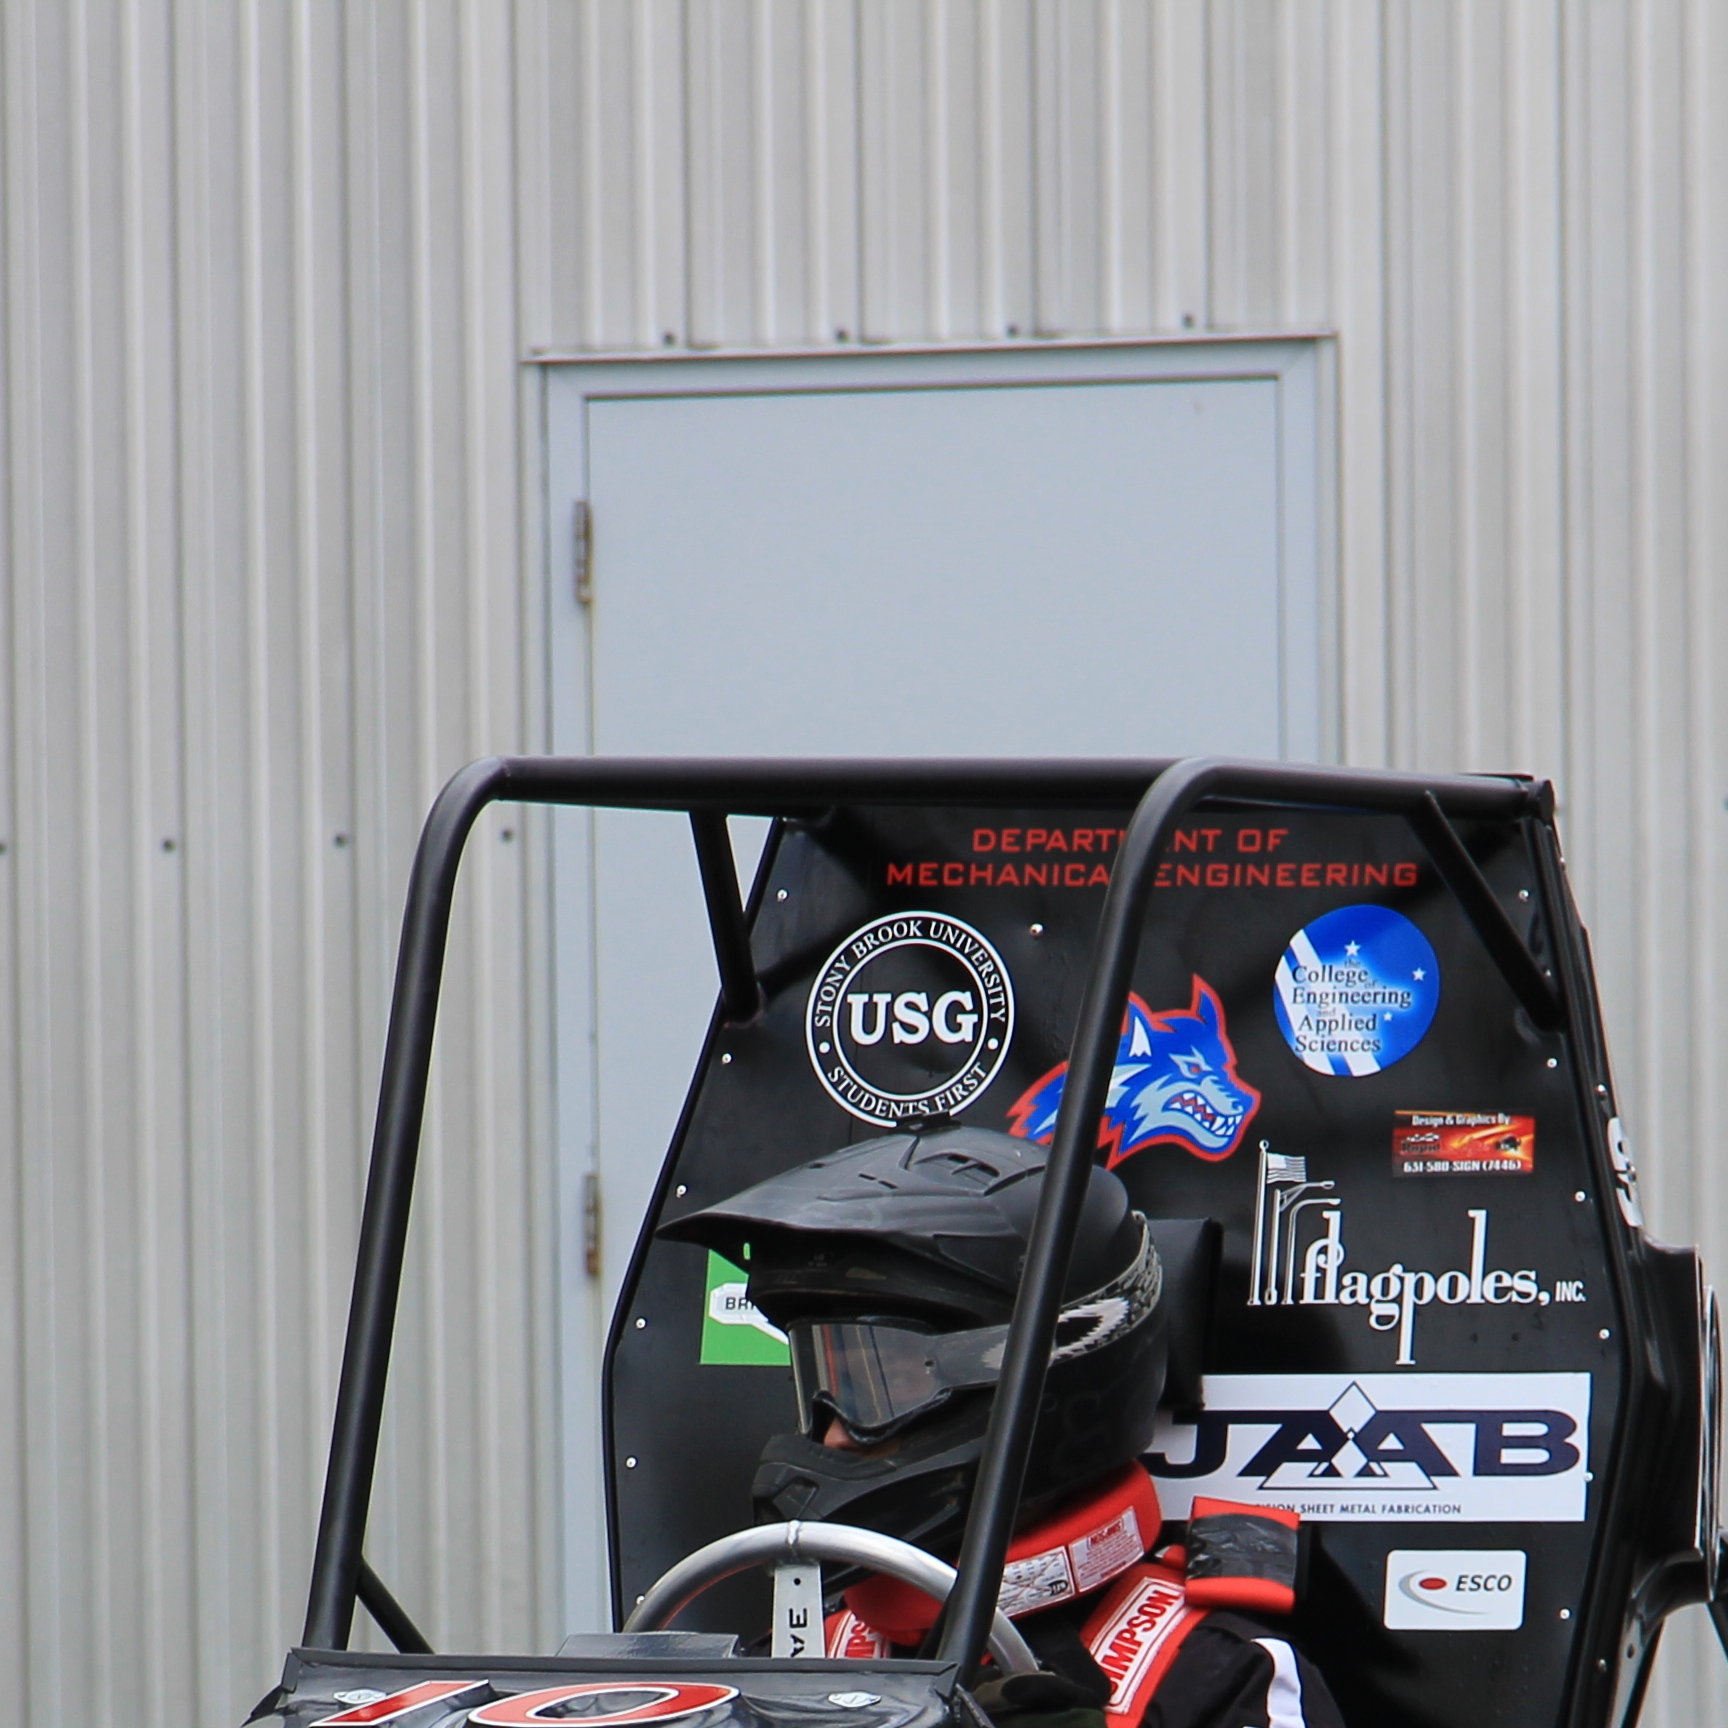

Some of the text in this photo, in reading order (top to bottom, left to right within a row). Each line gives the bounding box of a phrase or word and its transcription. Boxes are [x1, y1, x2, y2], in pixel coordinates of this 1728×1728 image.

[974, 828, 1289, 852] DEPARTNT OF
[887, 862, 1419, 887] MECHANICA ENGINEERING
[813, 919, 1007, 1028] STONY BROOK UNIVERSITY
[1292, 964, 1369, 987] College
[1292, 985, 1412, 1008] Engineering
[846, 990, 979, 1046] USG
[1298, 1013, 1378, 1035] Applied
[1294, 1034, 1382, 1053] Sciences
[827, 1061, 988, 1119] STUDENTS FIRST
[1555, 1281, 1587, 1303] INC.
[1138, 1408, 1581, 1479] JAAB
[1300, 1503, 1335, 1515] SHEET
[1339, 1503, 1377, 1515] METAL
[1381, 1503, 1462, 1515] FABRICATION
[1455, 1573, 1513, 1593] ESCO
[1099, 1589, 1182, 1700] IMPSON
[309, 1679, 741, 1728] 10
